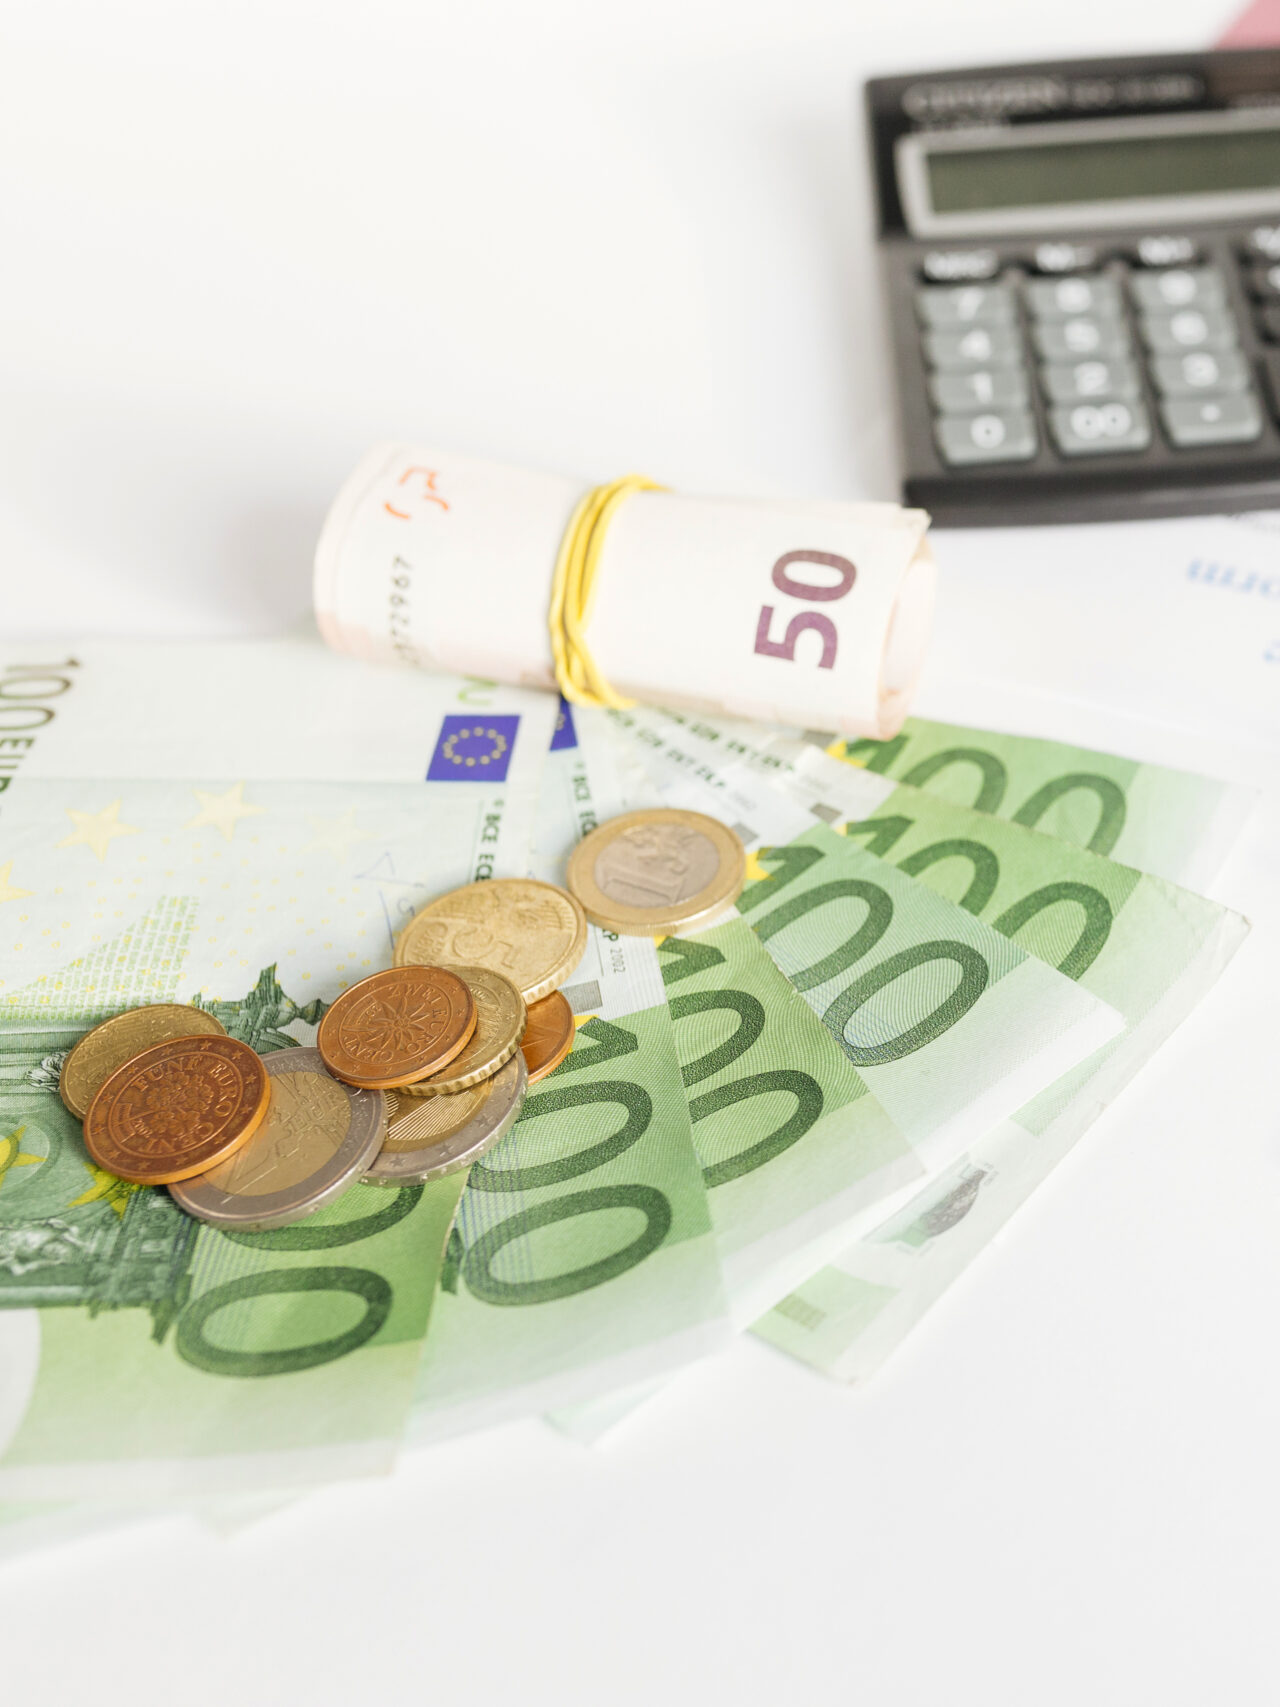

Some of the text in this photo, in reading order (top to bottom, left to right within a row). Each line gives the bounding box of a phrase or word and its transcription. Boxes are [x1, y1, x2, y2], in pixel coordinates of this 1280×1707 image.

[753, 549, 858, 671] 50
[388, 982, 442, 1006] ZWEI
[734, 845, 989, 1068] 100
[209, 1059, 239, 1117] EURO
[342, 1033, 394, 1064] CENT
[658, 935, 824, 1189] 100
[137, 1121, 215, 1154] CENT
[463, 1016, 673, 1307] 100
